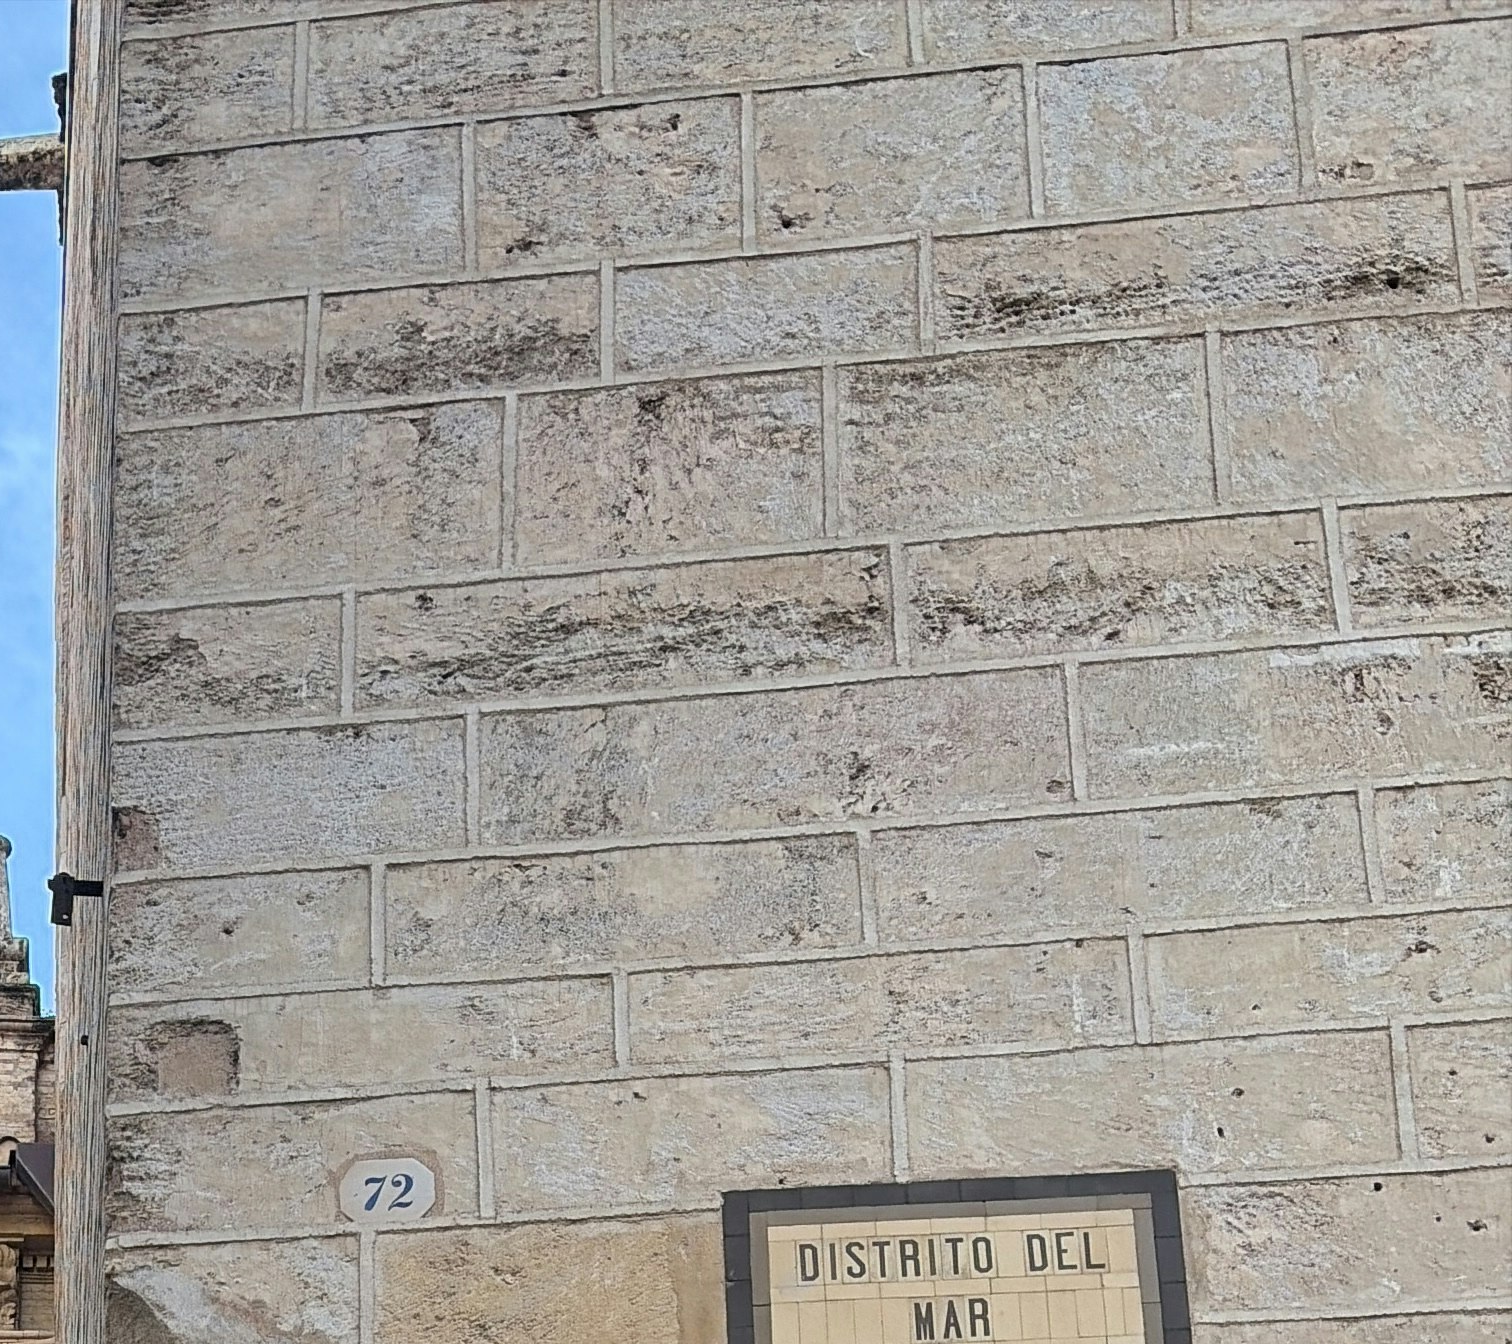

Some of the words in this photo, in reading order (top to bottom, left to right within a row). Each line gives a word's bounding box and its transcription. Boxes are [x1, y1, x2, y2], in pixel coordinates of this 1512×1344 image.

[364, 1173, 414, 1212] 72
[799, 1235, 995, 1283] DISTRITO
[1027, 1230, 1107, 1273] DEL
[914, 1297, 991, 1342] MAR
